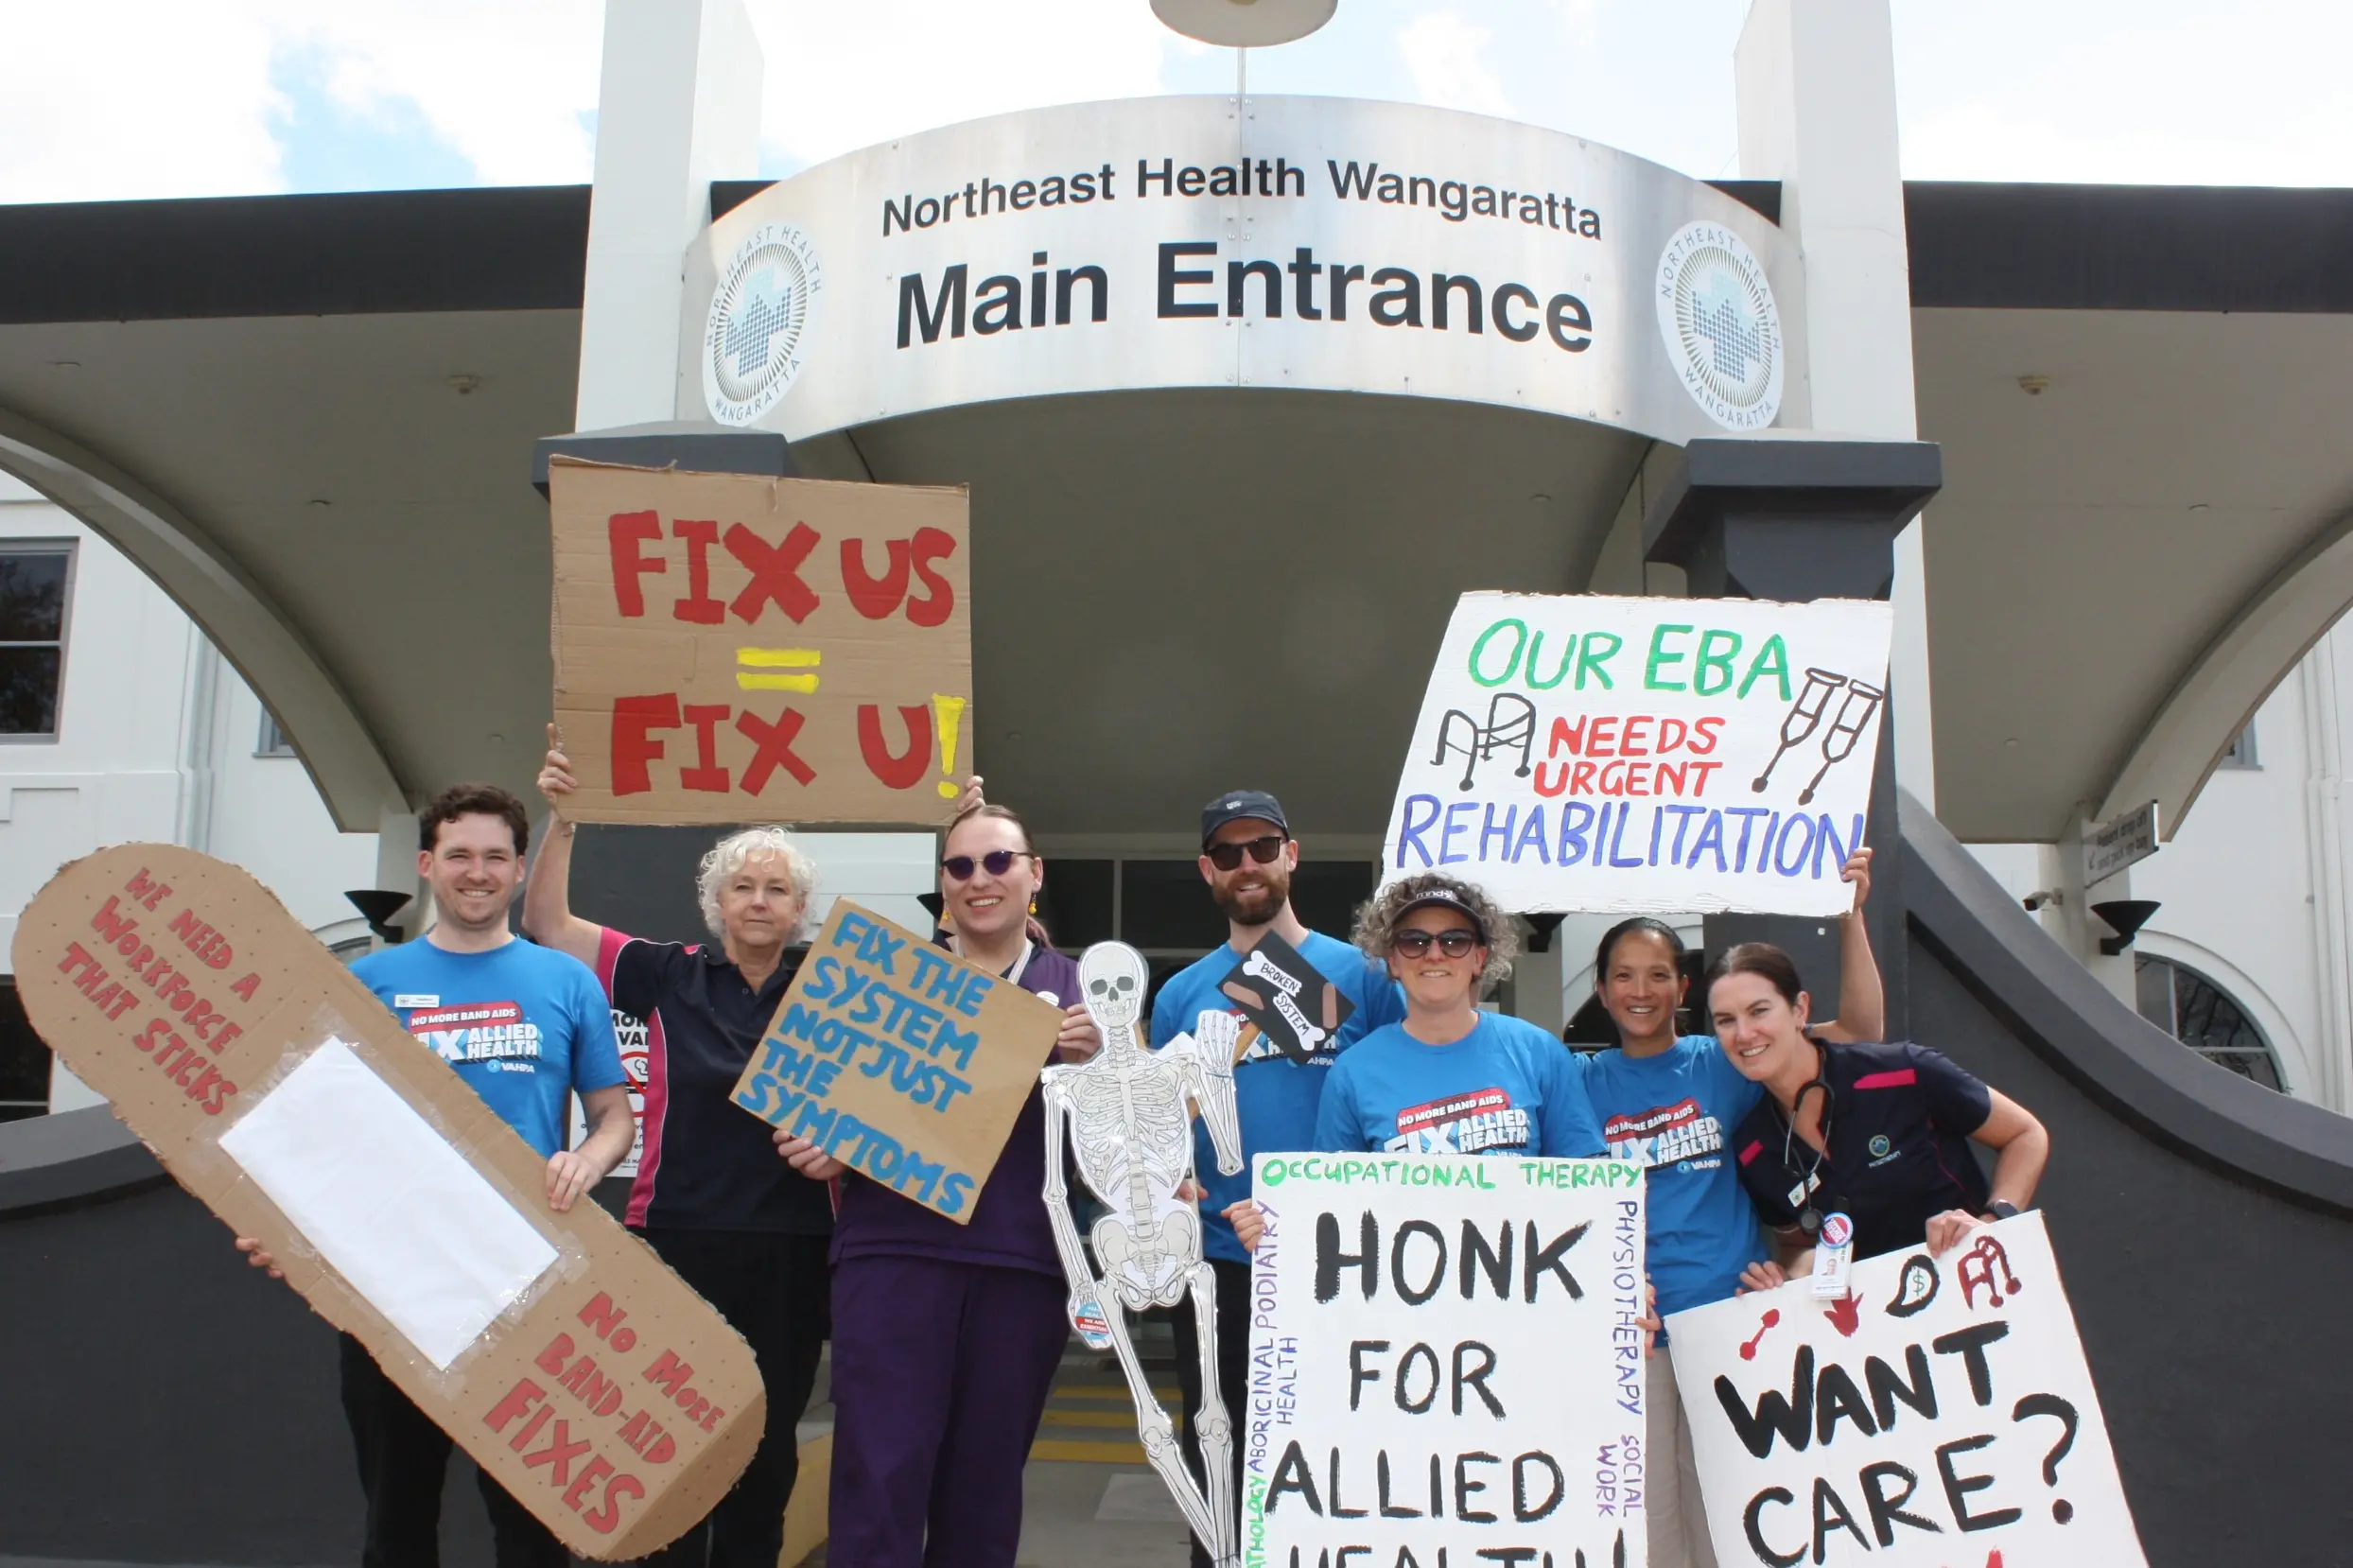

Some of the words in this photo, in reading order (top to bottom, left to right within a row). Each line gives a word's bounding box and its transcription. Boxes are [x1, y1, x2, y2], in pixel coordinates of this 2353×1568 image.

[882, 164, 1115, 236] Northeast
[1138, 157, 1305, 198] Health
[1327, 160, 1602, 241] Wangaratta
[781, 225, 821, 294] HEALTH
[897, 251, 1108, 350] Main
[1157, 242, 1594, 353] Entrance
[1662, 227, 1735, 299] NORTHEAST
[1744, 253, 1780, 350] HEALTH
[715, 358, 801, 421] WANGARATTA
[1685, 365, 1773, 427] WANGARATTA
[608, 510, 821, 625] FIX
[840, 527, 957, 627] US
[1468, 618, 1622, 691] OUR
[1644, 623, 1792, 701] EBA
[610, 692, 817, 797] FIX
[1533, 759, 1723, 797] URGENT
[1548, 714, 1726, 758] NEEDS
[1397, 793, 1864, 883] REHABILITATION
[90, 895, 244, 1055] WORKFORCE
[124, 866, 173, 913] WE
[166, 908, 233, 970] NEED
[230, 972, 262, 1002] A
[831, 912, 905, 975] FIX
[909, 948, 996, 1018] THE
[411, 1017, 427, 1026] NO
[428, 1012, 460, 1024] MORE
[461, 1009, 490, 1020] BAND
[492, 1008, 516, 1018] AIDS
[802, 956, 980, 1071] SYSTEM
[1260, 963, 1299, 991] BROKEN
[1276, 995, 1310, 1036] SYSTEM
[57, 941, 140, 1021] THAT
[131, 1018, 238, 1116] STICKS
[467, 1023, 538, 1043] ALLIED
[467, 1040, 538, 1058] HEALTH
[761, 1037, 844, 1098] THE
[777, 1002, 876, 1066] NOT
[859, 1040, 972, 1112] JUST
[737, 1072, 976, 1214] SYMPTOMS
[1398, 1116, 1414, 1126] NO
[1415, 1106, 1446, 1122] MORE
[1447, 1099, 1476, 1113] BAND
[1478, 1094, 1504, 1106] AIDS
[1457, 1109, 1527, 1136] ALLIED
[1458, 1126, 1527, 1152] HEALTH
[1605, 1125, 1619, 1135] NO
[1620, 1122, 1647, 1131] MORE
[1647, 1113, 1671, 1129] BAND
[1673, 1105, 1694, 1121] AIDS
[1657, 1133, 1720, 1164] HEALTH
[1658, 1116, 1718, 1150] ALLIED
[1262, 1158, 1495, 1189] OCCUPATIONAL
[1518, 1161, 1643, 1189] THERAPY
[1255, 1199, 1280, 1329] PODIATRY
[1315, 1208, 1595, 1306] HONK
[1612, 1200, 1643, 1416] PHYSIOTHERAPY
[533, 1332, 676, 1464] BAND-AID
[576, 1290, 636, 1353] NO
[641, 1349, 725, 1433] MORE
[1277, 1337, 1299, 1425] HEALTH
[1349, 1340, 1507, 1420] FOR
[1713, 1321, 2010, 1459] WANT
[482, 1377, 645, 1534] FIXES
[1264, 1439, 1565, 1524] ALLIED
[1595, 1443, 1618, 1518] WORK
[1620, 1434, 1643, 1518] SOCIAL
[1742, 1393, 2079, 1568] CARE?
